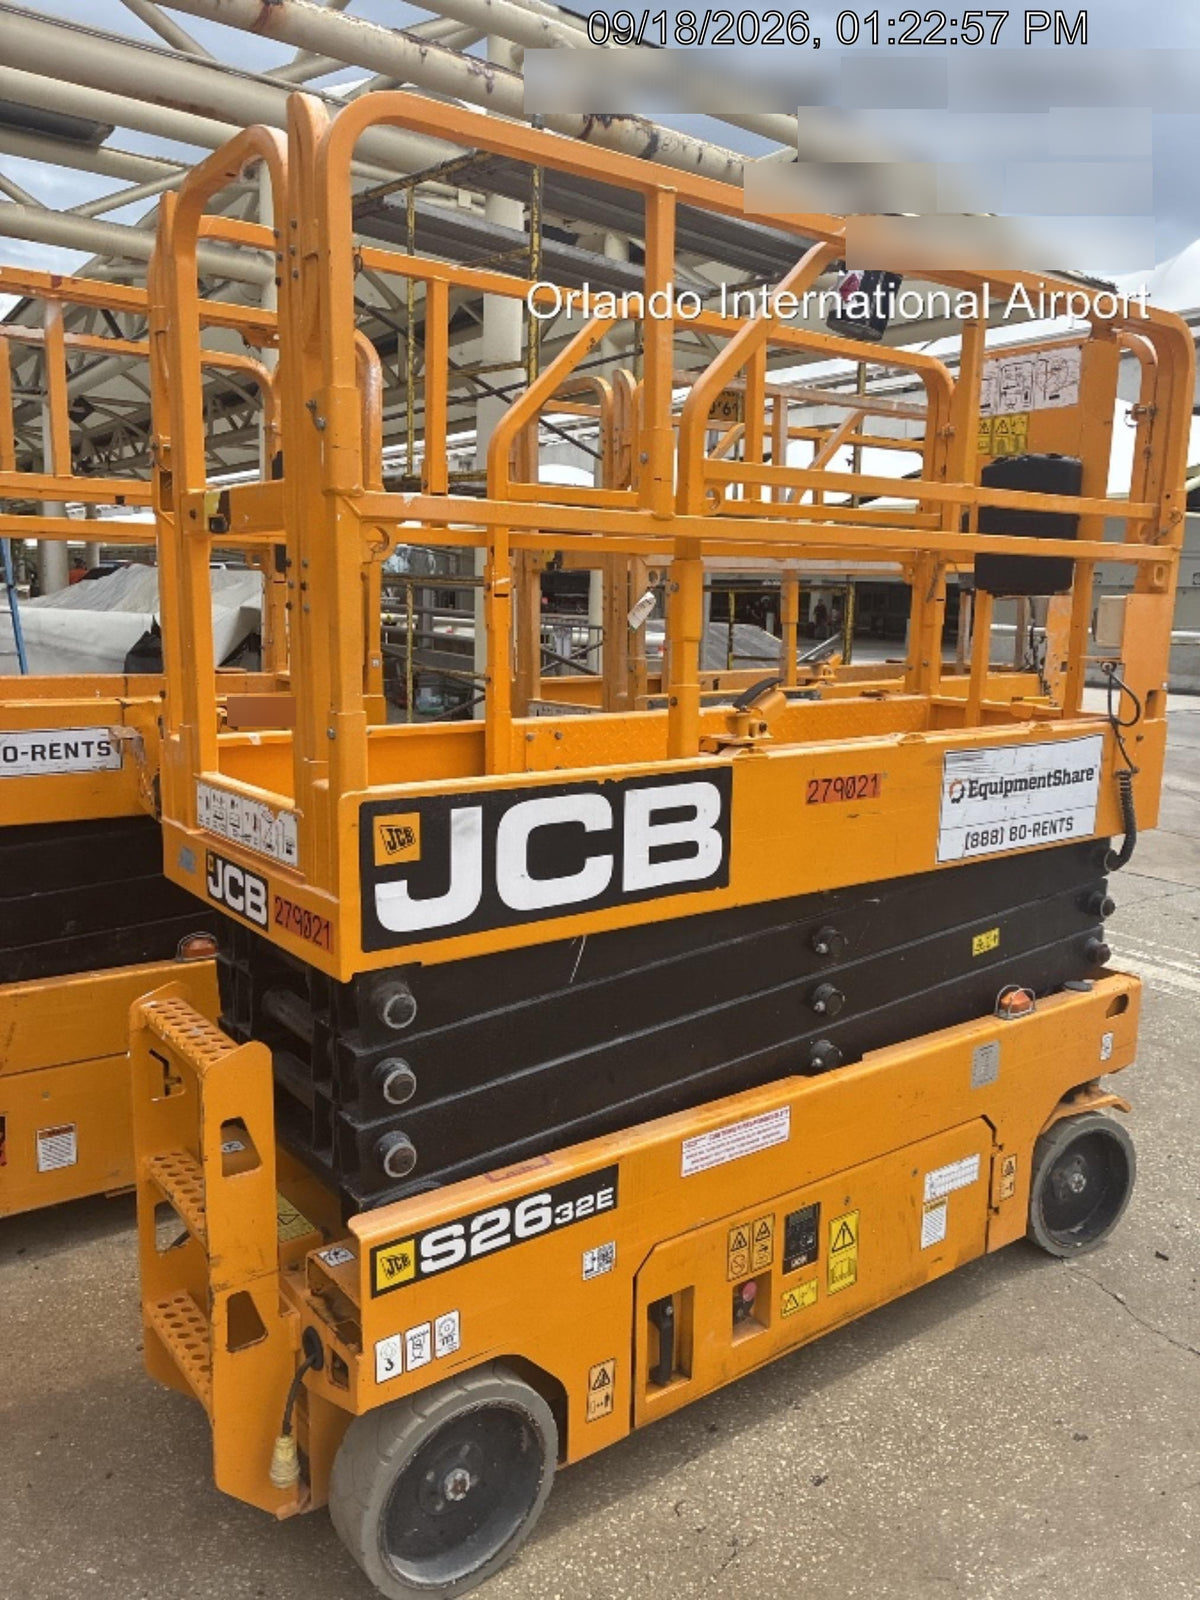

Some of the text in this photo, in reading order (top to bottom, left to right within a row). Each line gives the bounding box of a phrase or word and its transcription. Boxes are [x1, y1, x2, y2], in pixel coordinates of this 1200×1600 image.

[806, 773, 878, 804] 279021
[967, 767, 1095, 801] EquipmentShare
[386, 827, 413, 851] JCB
[965, 826, 1004, 851] (888)
[374, 781, 723, 933] JCB
[207, 858, 268, 926] JCB
[274, 896, 331, 950] 279021
